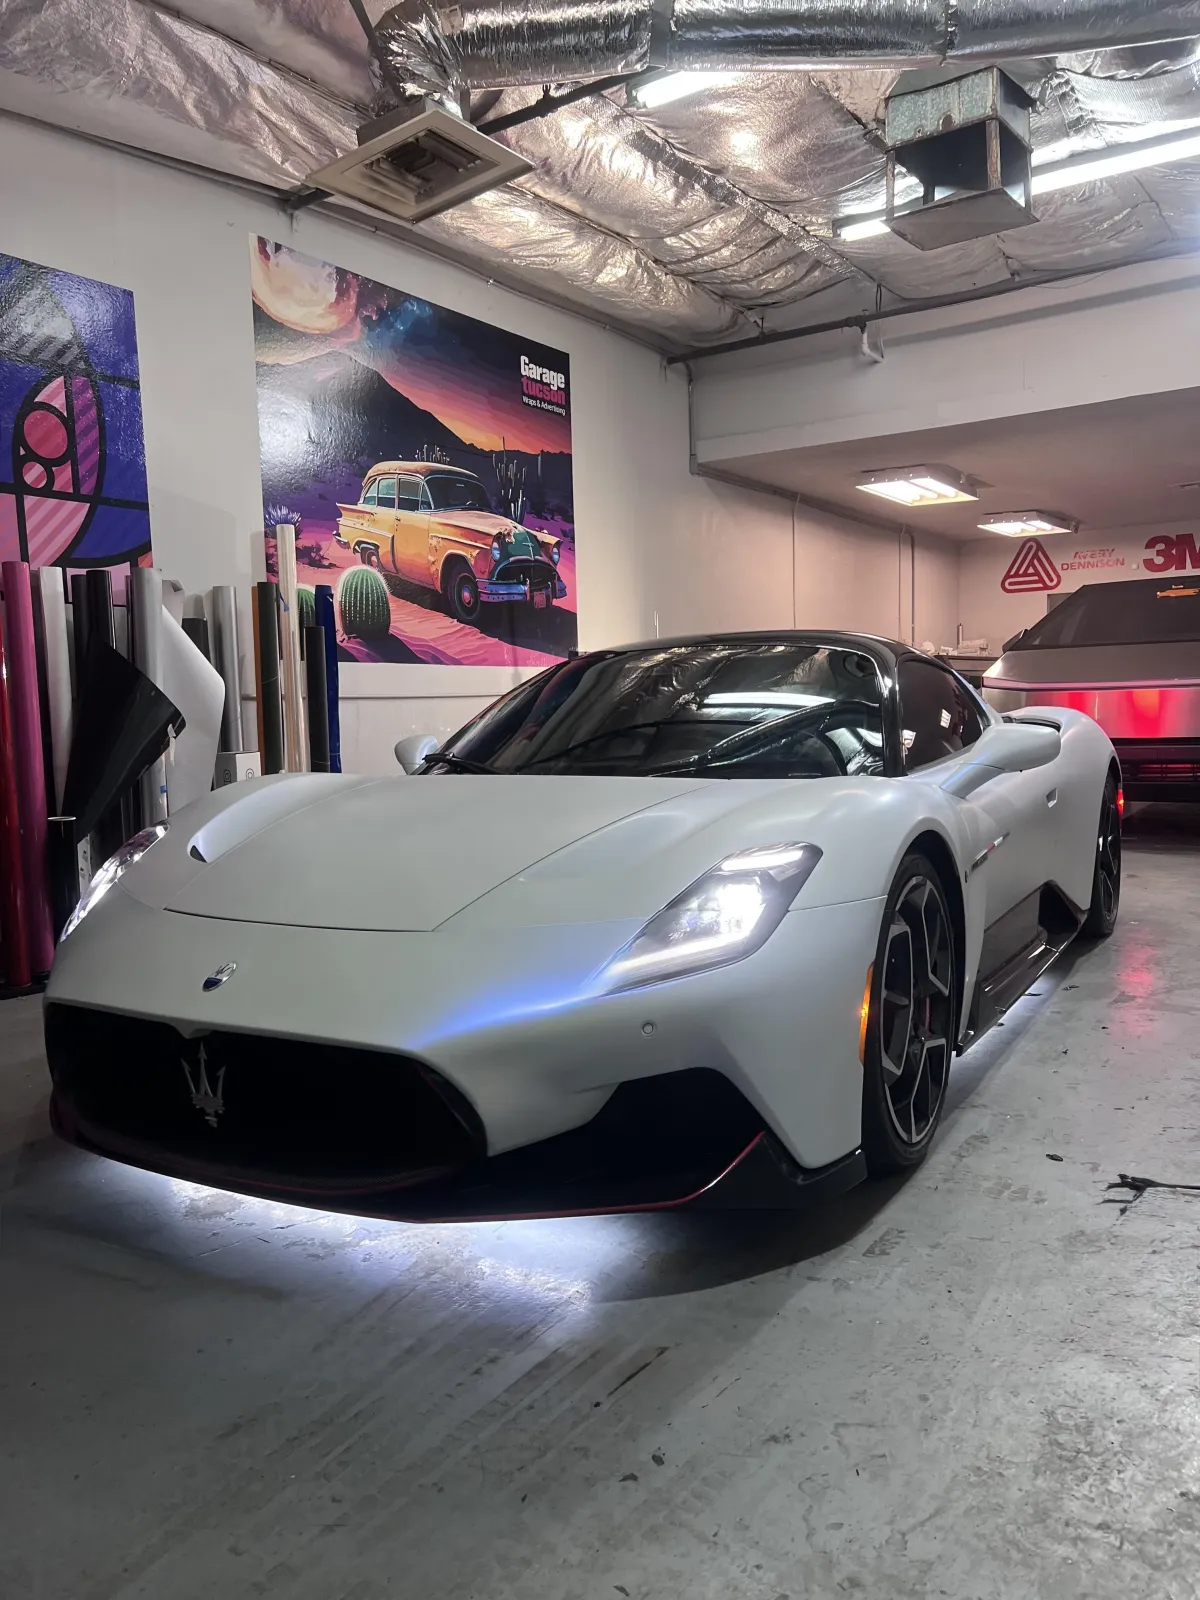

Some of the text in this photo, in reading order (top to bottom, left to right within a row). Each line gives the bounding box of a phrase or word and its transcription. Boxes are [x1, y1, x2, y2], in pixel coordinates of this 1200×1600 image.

[520, 355, 565, 390] Garage
[521, 376, 565, 405] tucson
[522, 396, 537, 406] Wraps
[540, 402, 565, 416] Advertising
[1073, 548, 1115, 560] AVERY
[1061, 558, 1125, 571] DENNISON
